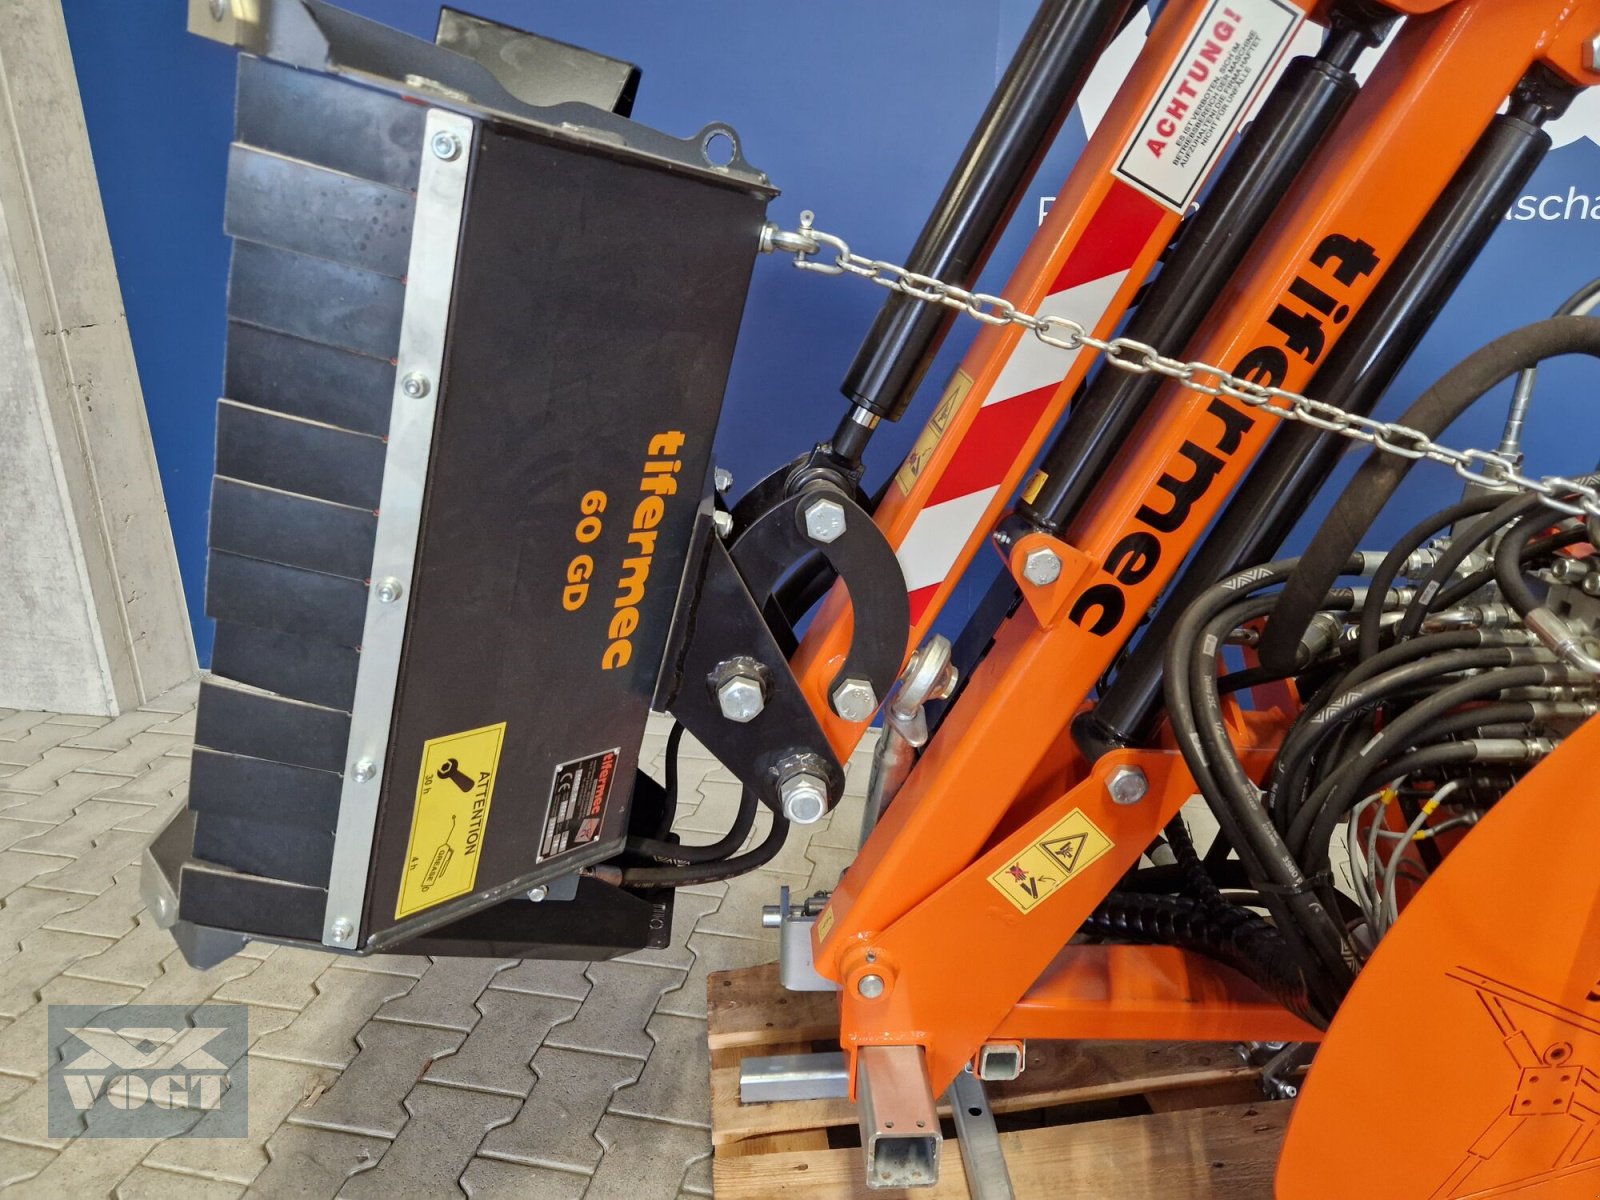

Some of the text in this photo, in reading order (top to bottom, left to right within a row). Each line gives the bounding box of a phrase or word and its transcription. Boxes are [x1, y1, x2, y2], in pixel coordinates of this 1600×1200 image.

[1146, 7, 1243, 159] ACHTUNG!
[1173, 31, 1255, 166] BETRIEBSBEREICH DER MASCHINE
[1175, 135, 1185, 146] ES
[1183, 122, 1193, 134] IST
[1218, 53, 1234, 74] SICH
[1231, 42, 1240, 52] IM
[1215, 94, 1226, 108] DIE
[1223, 68, 1241, 94] FIRMA
[1239, 35, 1262, 68] HAFTET
[1201, 122, 1218, 146] NICHT
[1068, 233, 1381, 637] tifermec
[562, 490, 607, 610] 60 GD
[602, 431, 685, 670] tifermec
[424, 774, 433, 785] 30
[465, 771, 490, 856] ATTENTION
[591, 752, 614, 815] tifermec
[426, 850, 445, 881] GREASE
